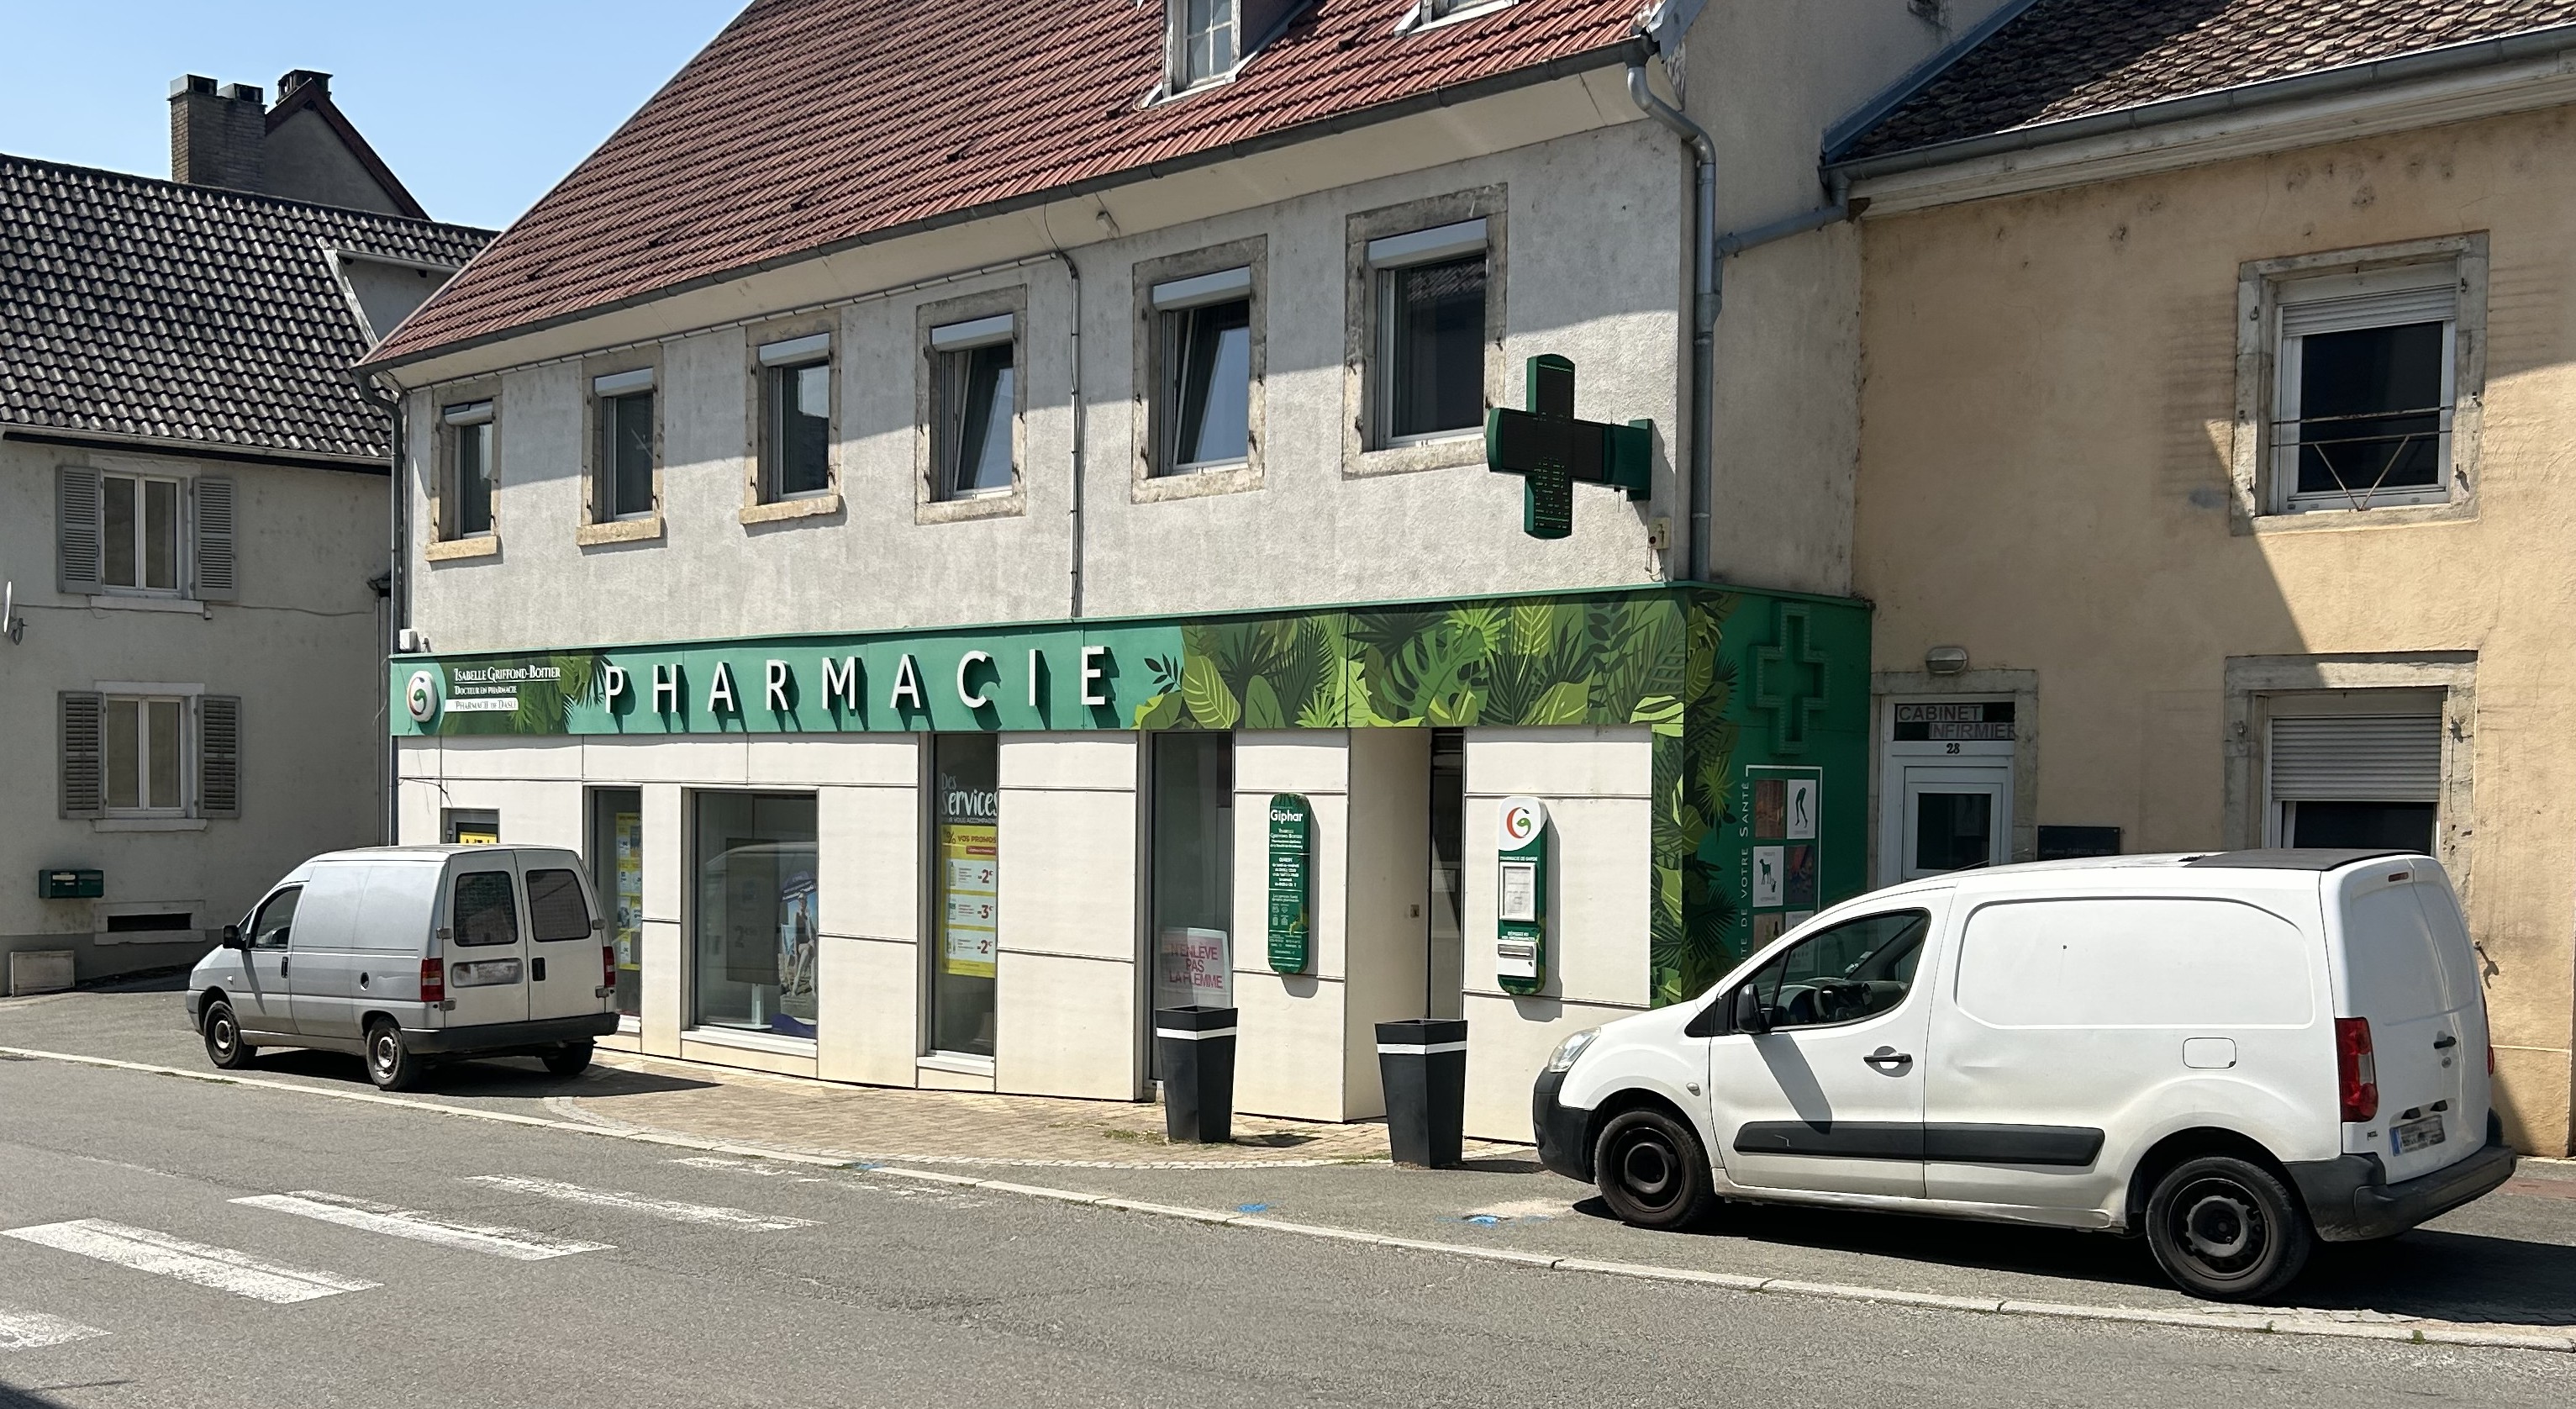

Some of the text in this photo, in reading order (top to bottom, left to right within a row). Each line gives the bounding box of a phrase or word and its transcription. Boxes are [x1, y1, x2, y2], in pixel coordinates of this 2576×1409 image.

[605, 646, 1106, 715] PHARMACIE
[1899, 705, 1981, 721] CABINET
[1930, 724, 2015, 740] INFIRMIER
[1946, 743, 1960, 754] 28
[1270, 810, 1304, 825] Giphar
[1739, 782, 1750, 837] SANTÉ
[1741, 847, 1749, 899] VOTRE
[1741, 909, 1748, 927] DE
[1185, 958, 1205, 974] PAS
